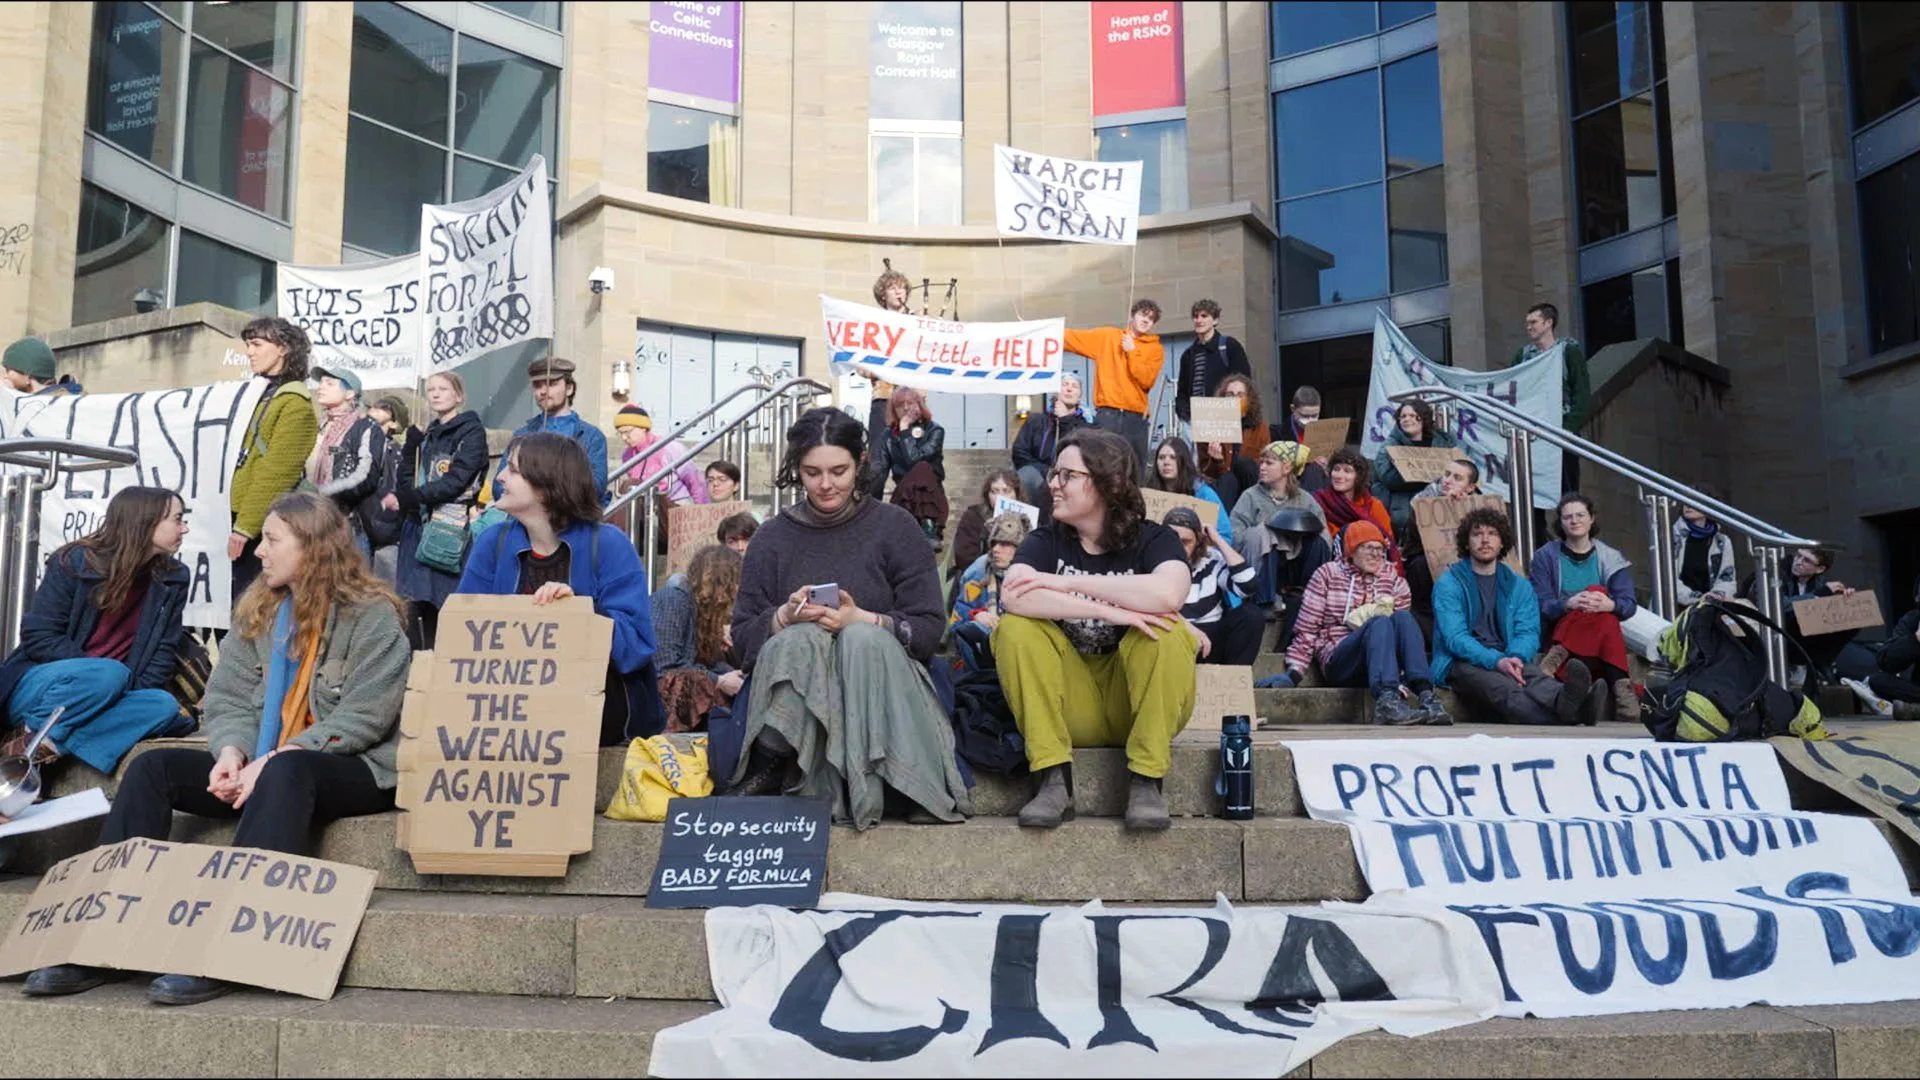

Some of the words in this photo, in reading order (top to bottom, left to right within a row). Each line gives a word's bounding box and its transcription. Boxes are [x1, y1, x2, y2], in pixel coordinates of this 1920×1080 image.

[673, 11, 712, 29] Celtic
[706, 5, 721, 16] of
[1110, 15, 1150, 28] Home
[1153, 9, 1168, 22] of
[650, 20, 734, 48] Connections
[878, 22, 937, 36] Welcome
[941, 26, 954, 37] to
[887, 37, 944, 52] Glasgow
[1108, 31, 1130, 43] the
[1133, 24, 1172, 40] RSNO
[875, 64, 929, 78] Concert
[930, 67, 956, 79] Hall
[897, 51, 934, 66] Royal
[1041, 182, 1088, 212] FOR
[1008, 203, 1126, 240] SCRAN
[287, 287, 363, 317] THIS
[383, 280, 420, 316] IS
[426, 272, 477, 314] FOR
[826, 320, 906, 357] VERY
[915, 319, 965, 334] TESCO
[992, 337, 1060, 369] HELP
[465, 620, 559, 651] YE'VE
[450, 658, 558, 685] TURNED
[466, 693, 529, 722] THE
[437, 725, 567, 766] WEANS
[424, 768, 570, 808] AGAINST
[1332, 758, 1555, 818] PROFIT
[468, 809, 516, 849] YE
[672, 812, 736, 838] Stop
[738, 815, 817, 842] security
[92, 840, 170, 873] CAN'T
[197, 849, 338, 895] AFFORD
[703, 843, 784, 868] tagging
[660, 868, 721, 887] BABY
[725, 867, 812, 884] FORMULA
[20, 898, 64, 936] THE
[63, 891, 142, 924] COST
[168, 900, 211, 927] OF
[230, 905, 337, 951] DYING
[1445, 898, 1779, 1002] FOOD
